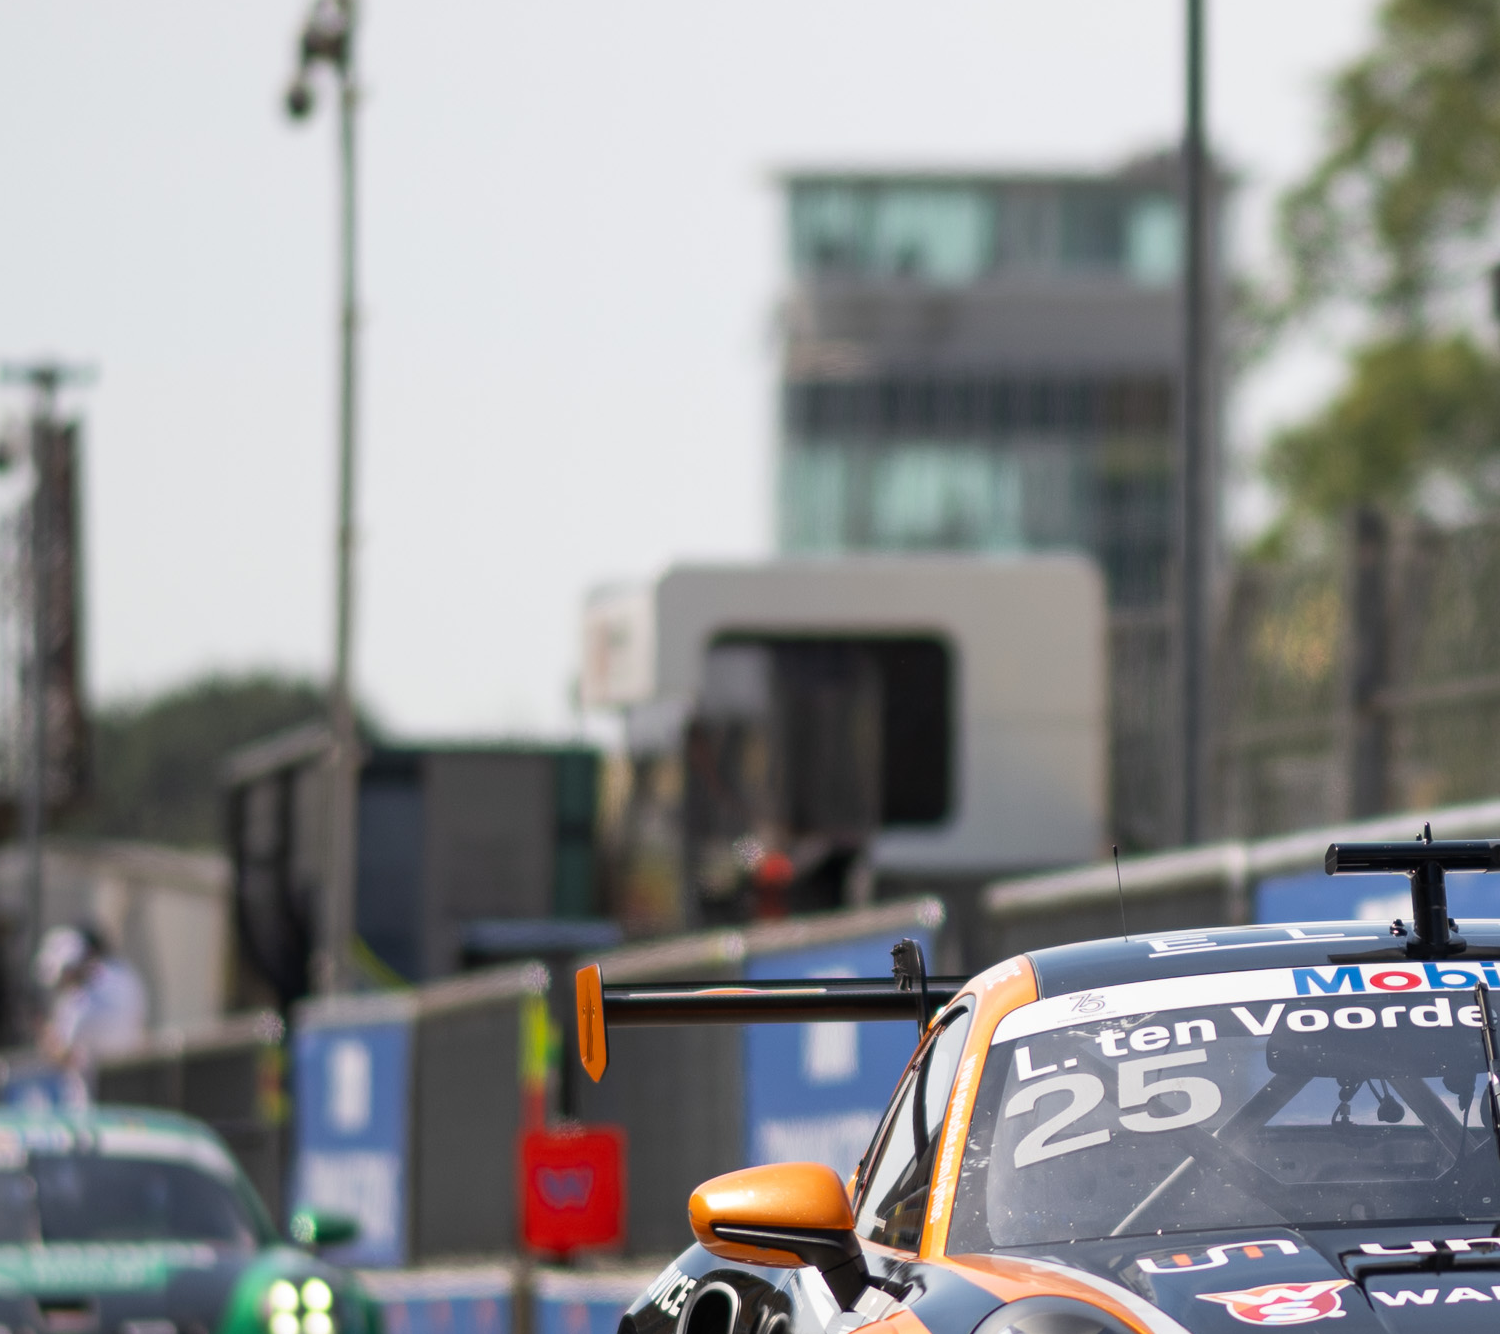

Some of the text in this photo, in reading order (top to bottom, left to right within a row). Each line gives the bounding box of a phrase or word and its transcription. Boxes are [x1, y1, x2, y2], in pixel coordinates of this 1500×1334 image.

[1014, 998, 1499, 1082] L. ten Voorde
[1004, 1048, 1223, 1169] 25
